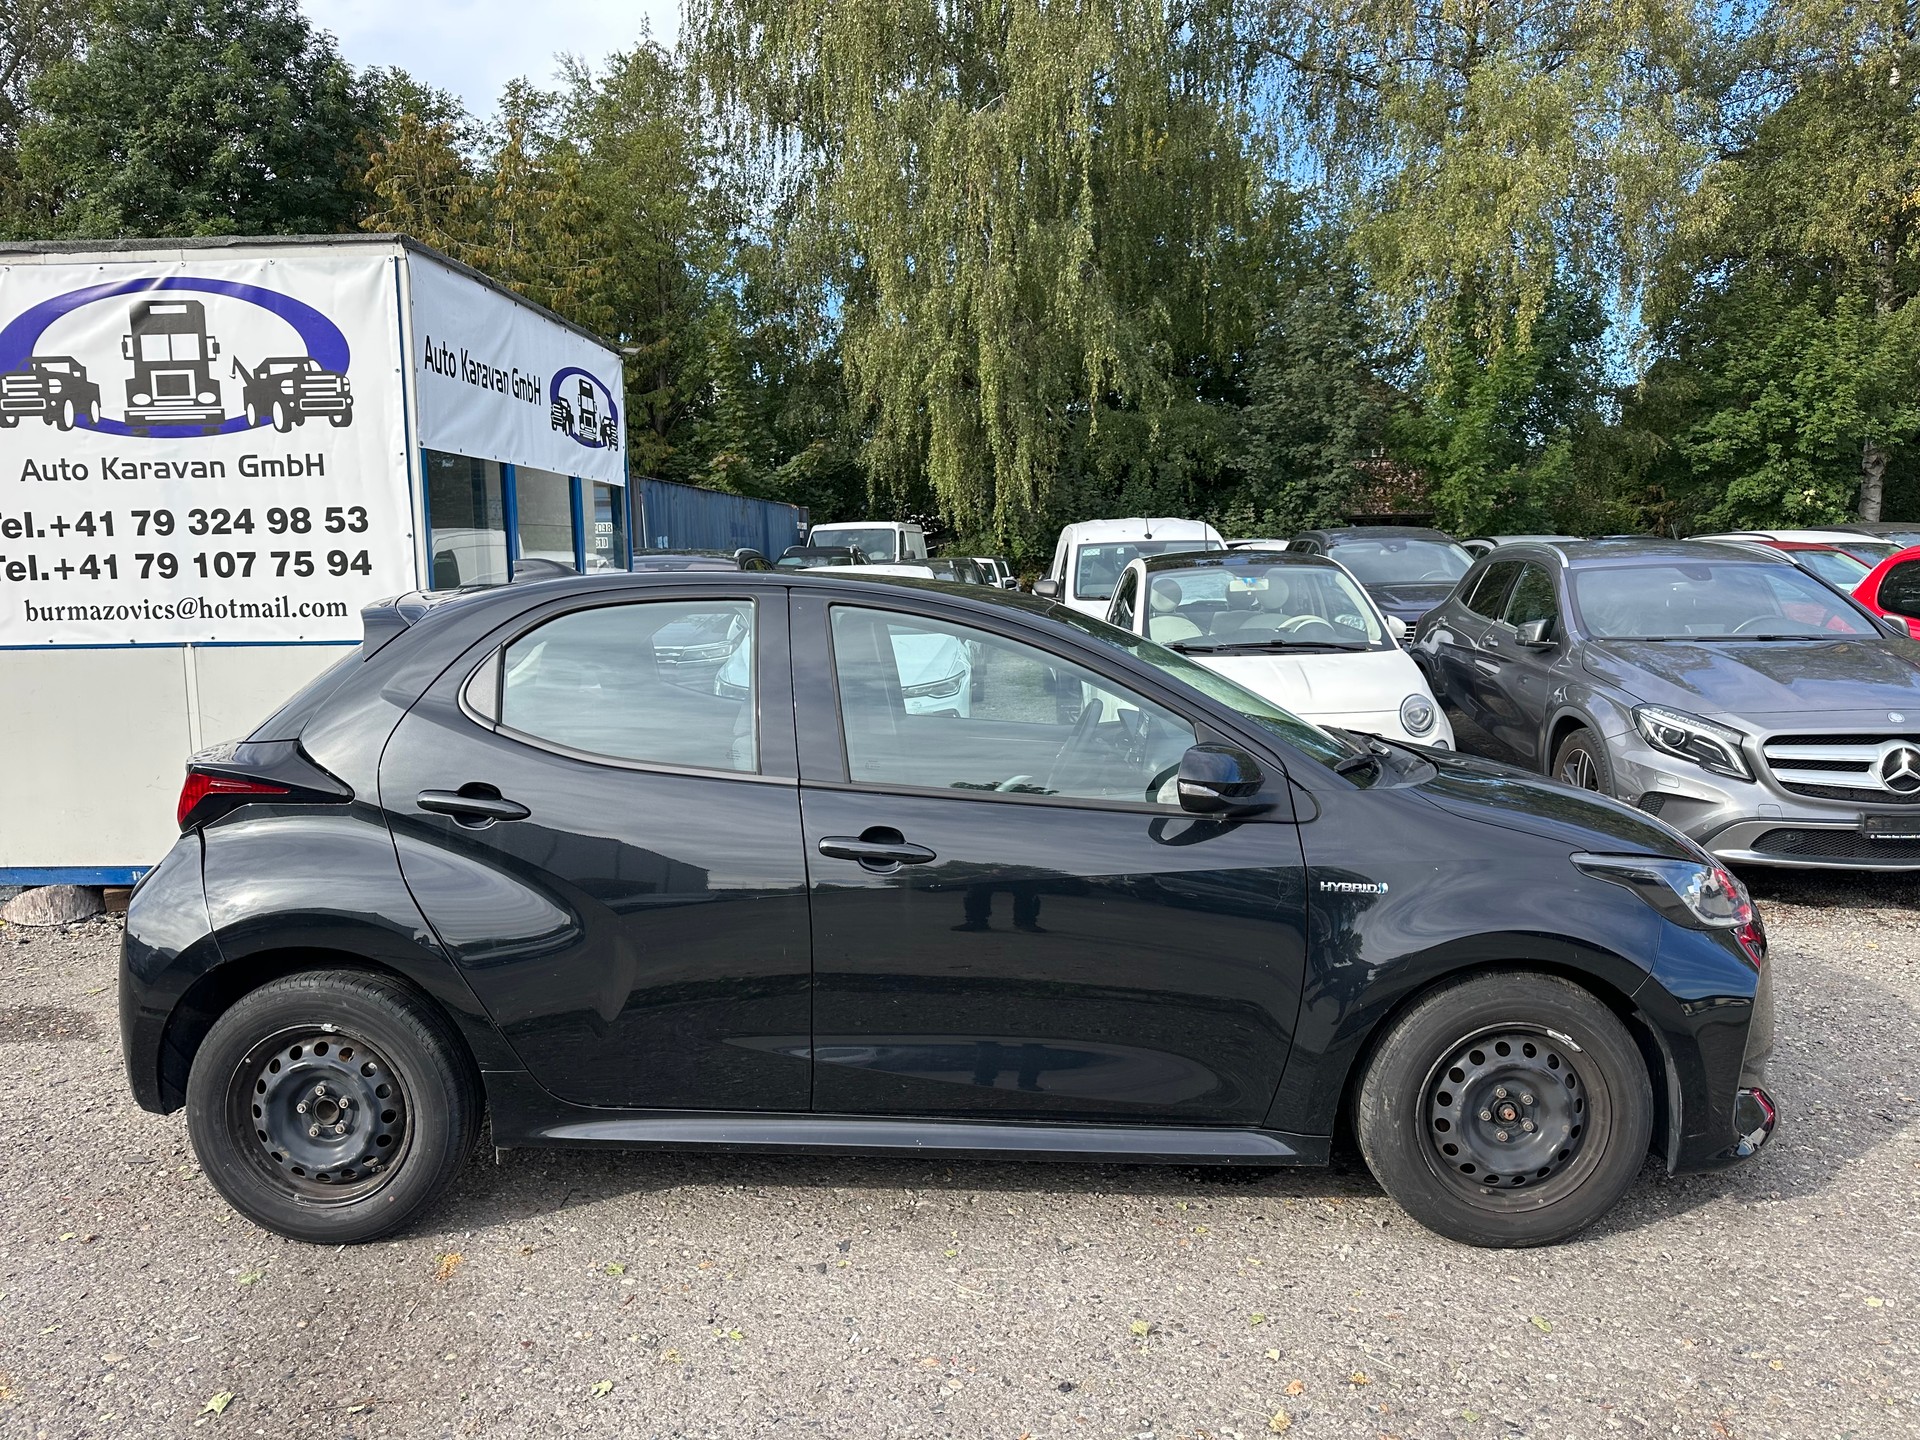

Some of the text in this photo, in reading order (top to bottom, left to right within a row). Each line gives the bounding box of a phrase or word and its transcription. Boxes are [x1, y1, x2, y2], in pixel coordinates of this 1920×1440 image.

[424, 335, 542, 406] Auto Karavan GmbH
[20, 453, 325, 482] Auto Karavan GmbH
[0, 506, 369, 539] el.+41 79 324 98 53
[135, 552, 179, 579] 79
[193, 551, 257, 578] 107
[270, 551, 315, 577] 75
[326, 549, 372, 577] 94
[24, 595, 348, 622] burmazovics@hotmail.com
[1320, 881, 1378, 893] HYBRID
